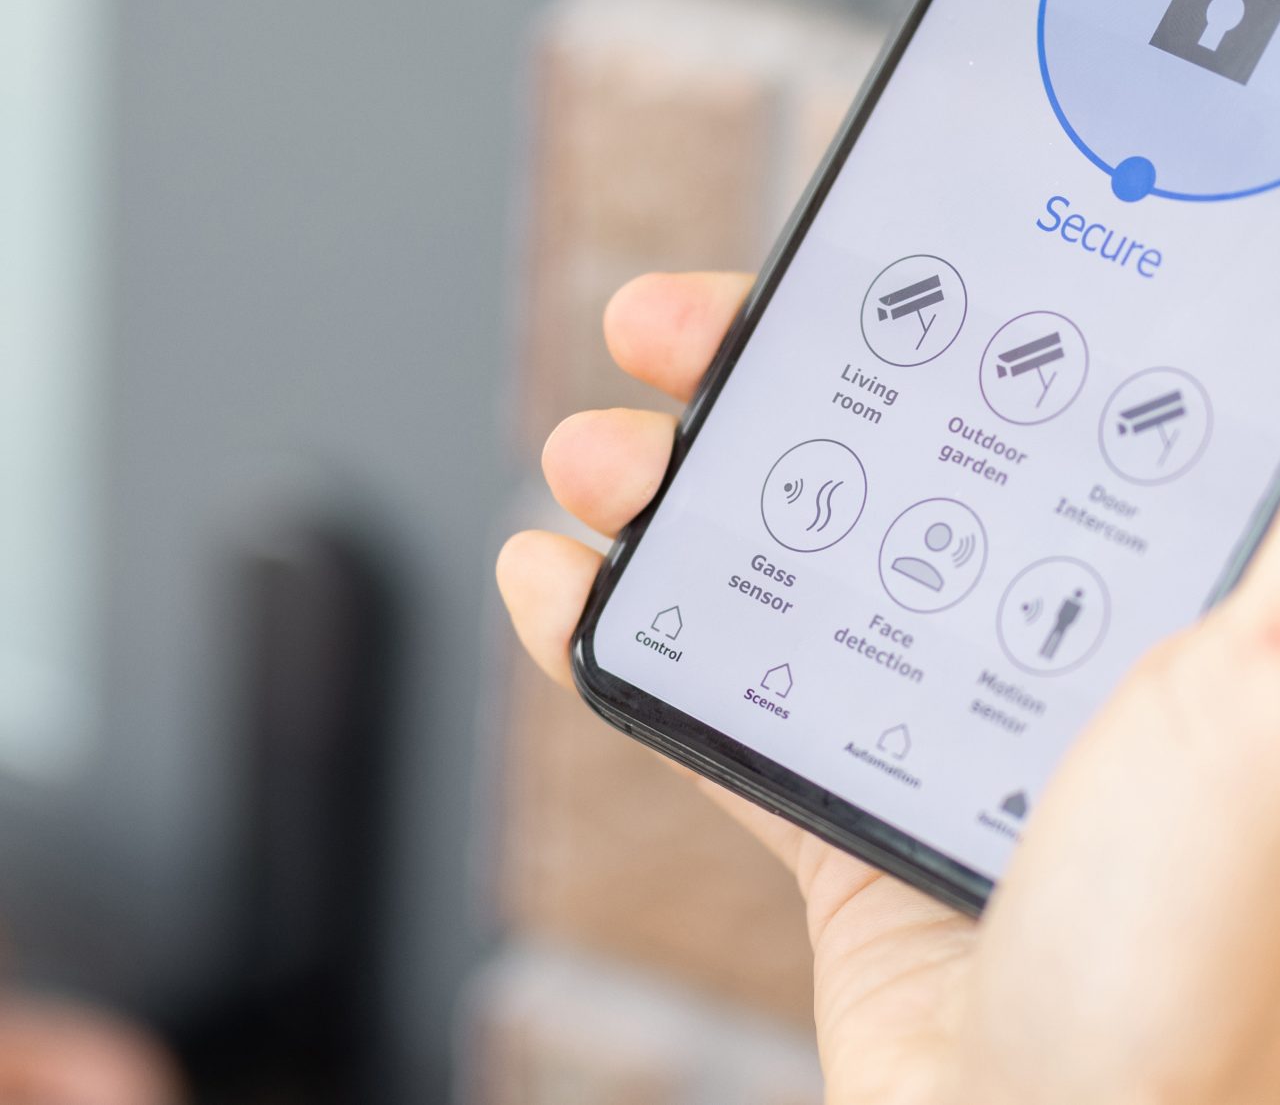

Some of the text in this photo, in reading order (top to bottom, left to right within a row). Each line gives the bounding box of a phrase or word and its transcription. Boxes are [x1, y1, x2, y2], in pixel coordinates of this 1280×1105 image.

[1035, 195, 1162, 278] Secure
[840, 364, 899, 406] Living
[831, 391, 882, 424] room
[947, 416, 1027, 464] Outdoor
[937, 444, 1008, 486] garden
[1088, 484, 1138, 517] Door
[1054, 496, 1147, 552] Intercom
[750, 554, 797, 588] Gass
[727, 575, 794, 614] sensor
[635, 630, 683, 663] Control
[869, 614, 914, 649] Face
[833, 627, 924, 682] detection
[743, 688, 790, 720] Scenes
[977, 670, 1045, 714] Motion
[970, 699, 1026, 733] sensor
[843, 741, 920, 789] Automation
